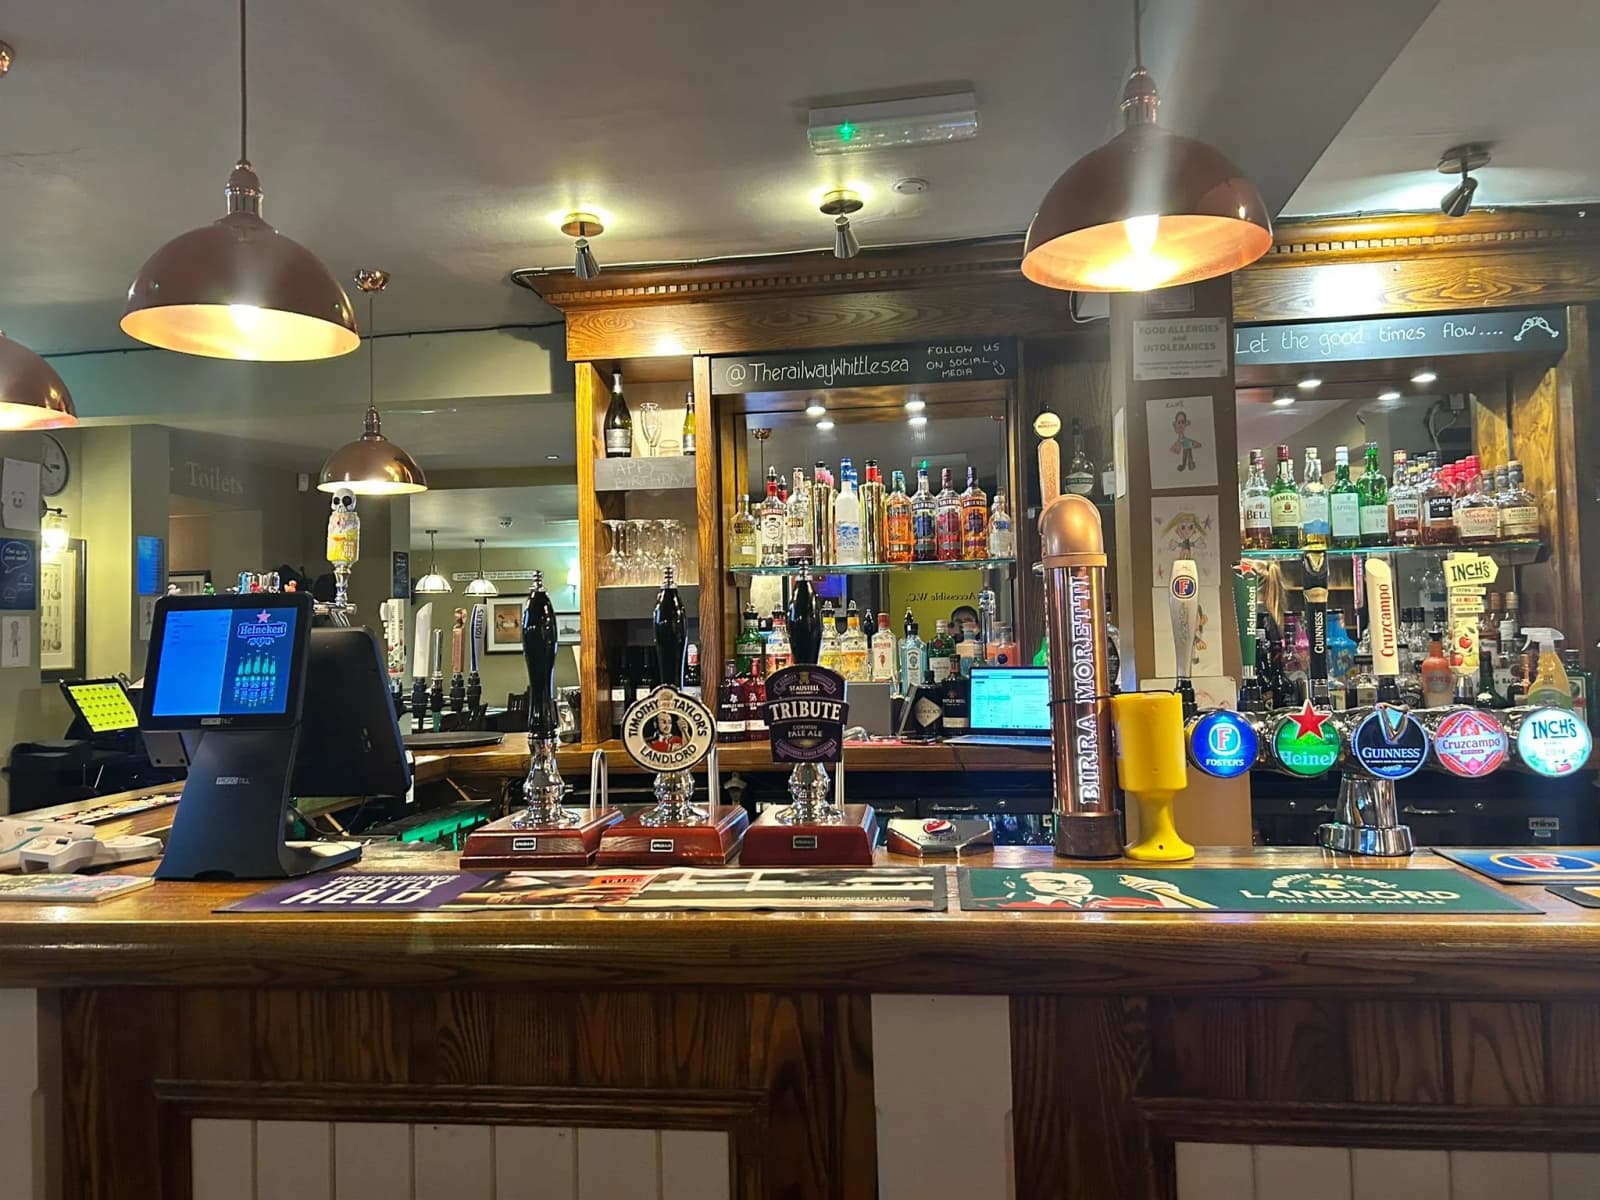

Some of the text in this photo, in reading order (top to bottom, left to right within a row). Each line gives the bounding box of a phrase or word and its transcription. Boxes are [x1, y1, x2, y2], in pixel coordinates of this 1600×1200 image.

[1138, 324, 1219, 336] FOOD ALLERGIES
[1143, 342, 1217, 353] INTOLERANCES
[1235, 332, 1270, 354] Let
[1281, 330, 1309, 350] the
[1318, 326, 1365, 356] good
[1379, 325, 1426, 343] times
[927, 342, 1000, 356] FOLLOW US
[926, 357, 990, 371] ON SOCIAL
[941, 367, 973, 379] MEDIA
[185, 460, 244, 495] Toilets
[1430, 498, 1452, 506] JURA
[1246, 585, 1257, 636] Heineken
[1379, 583, 1395, 658] Cruzcampo
[240, 625, 284, 635] Heineken
[1314, 611, 1324, 654] GUINNESS
[1070, 575, 1096, 704] MORETTI
[629, 698, 707, 738] TIMOTHY TAYLOR'S
[769, 701, 842, 721] TRIBUTE
[640, 744, 697, 764] LANDLORD
[1362, 747, 1421, 759] GUINNESS
[1442, 739, 1501, 754] Cruzcampo
[1076, 713, 1101, 805] BIRRA
[319, 880, 451, 890] TIGHTLY
[279, 889, 433, 905] HELD
[1239, 889, 1462, 900] LANDLORD
